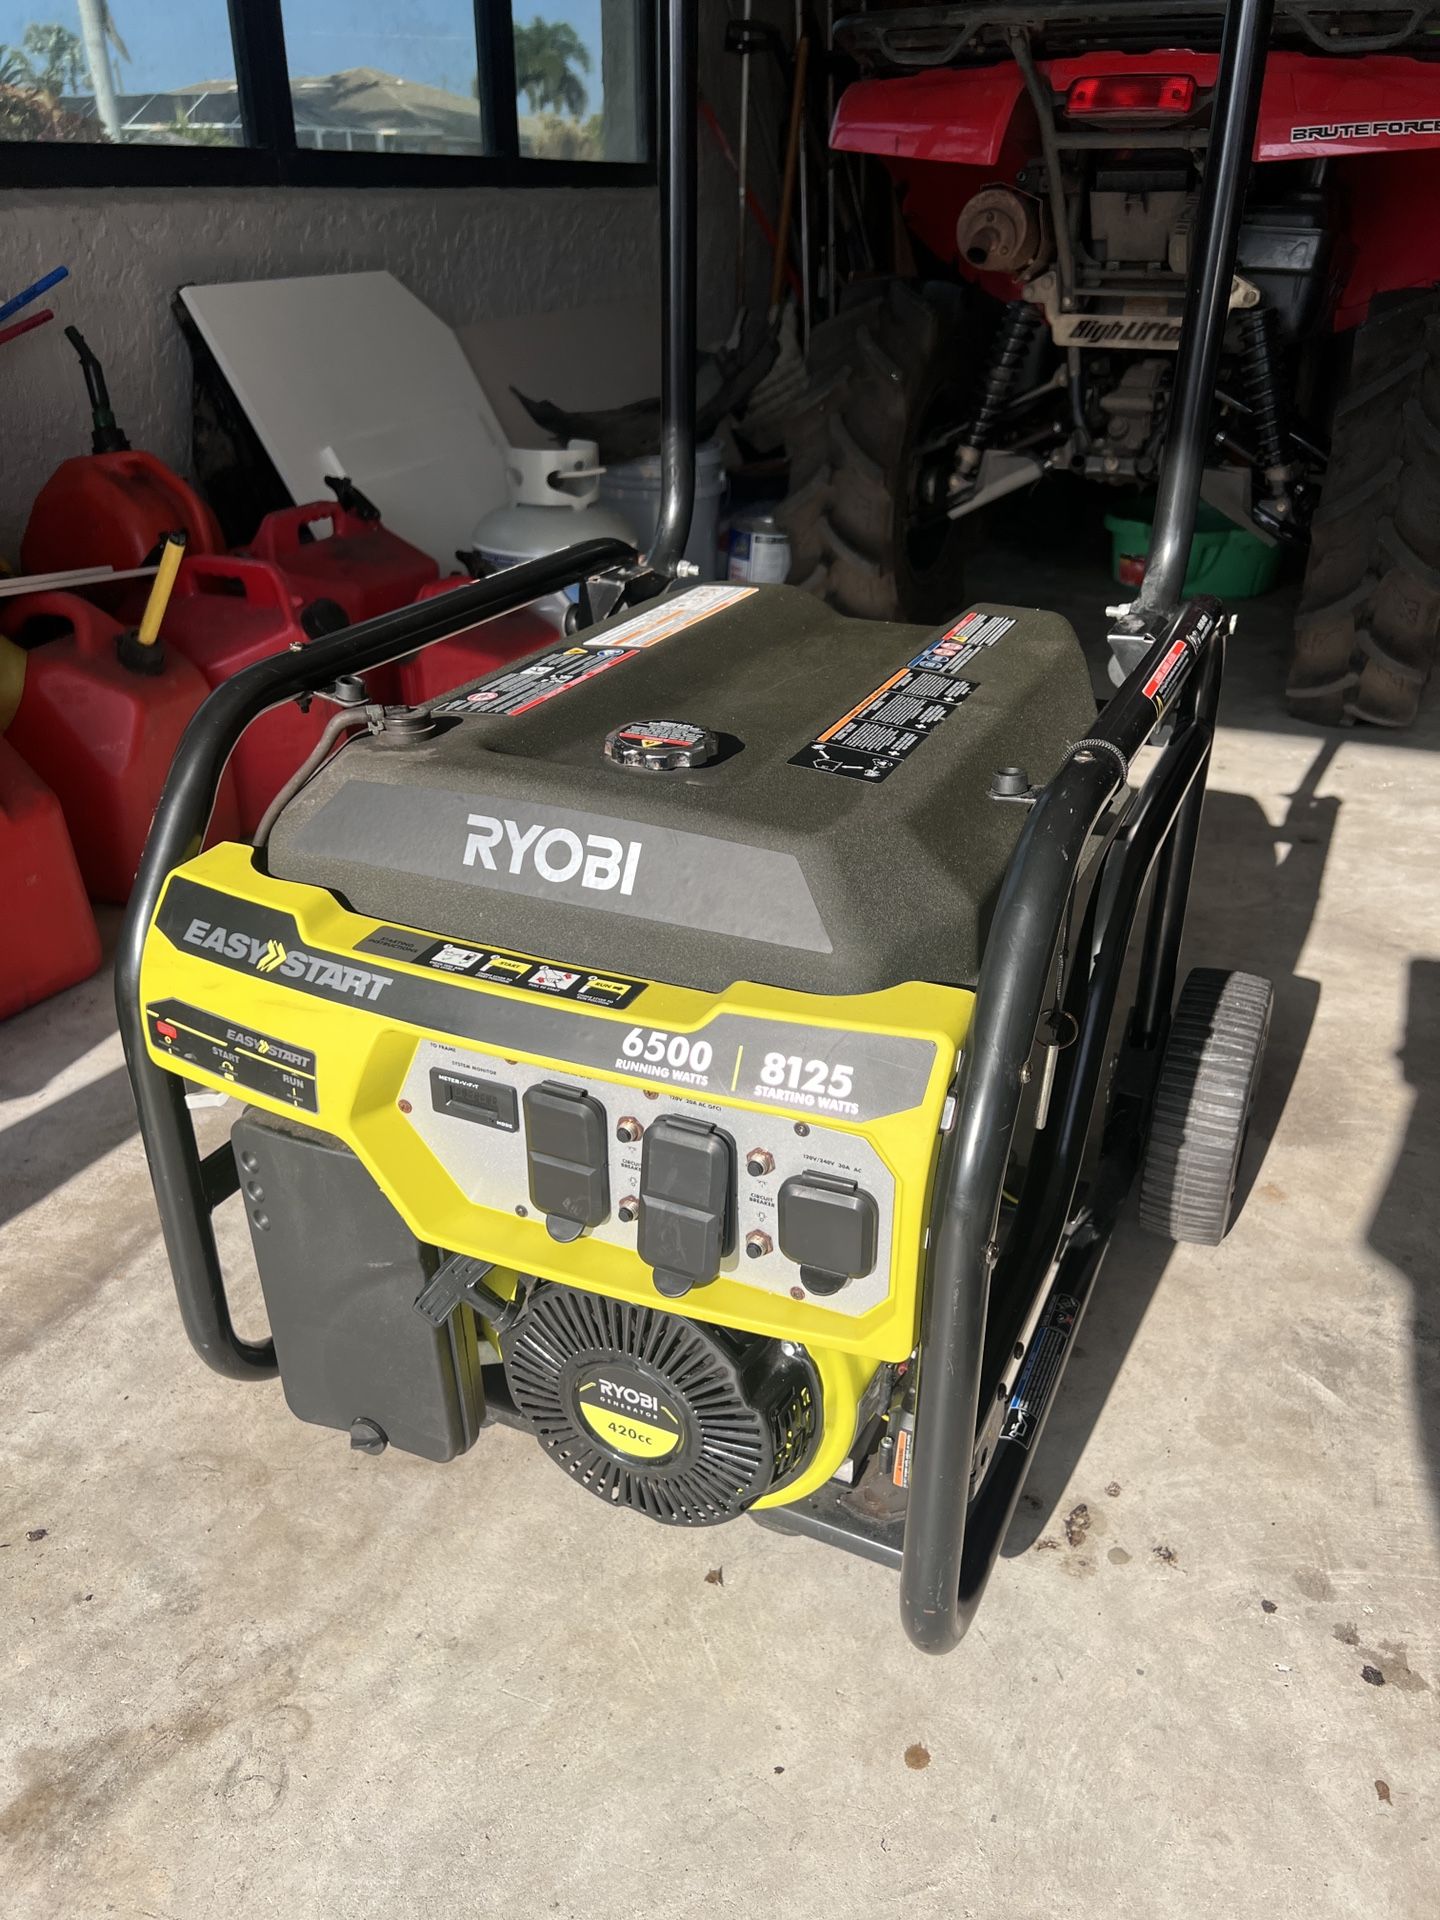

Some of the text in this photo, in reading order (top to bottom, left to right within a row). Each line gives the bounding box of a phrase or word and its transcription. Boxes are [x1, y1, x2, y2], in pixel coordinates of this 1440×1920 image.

[1291, 123, 1370, 142] BRUTE
[1069, 320, 1181, 343] High Lifte
[462, 813, 642, 896] RYOBI
[183, 918, 393, 1001] EASY START
[499, 961, 521, 969] START
[212, 1046, 240, 1064] START
[226, 1029, 310, 1068] EASY START
[439, 1044, 456, 1052] FRAME
[621, 1027, 713, 1072] 6500
[452, 1060, 497, 1075] SYSTEM MONITOR
[615, 1058, 669, 1079] RUNNING
[672, 1069, 709, 1087] WATTS
[760, 1052, 854, 1098] 8125
[282, 1073, 304, 1089] RUN
[754, 1085, 859, 1115] STARTING WATTS
[749, 1196, 775, 1208] BREAKER
[750, 1192, 773, 1202] CIRCUIT
[598, 1378, 658, 1412] RYOBI
[599, 1396, 658, 1420] GENERATOR
[608, 1422, 653, 1446] 420cc
